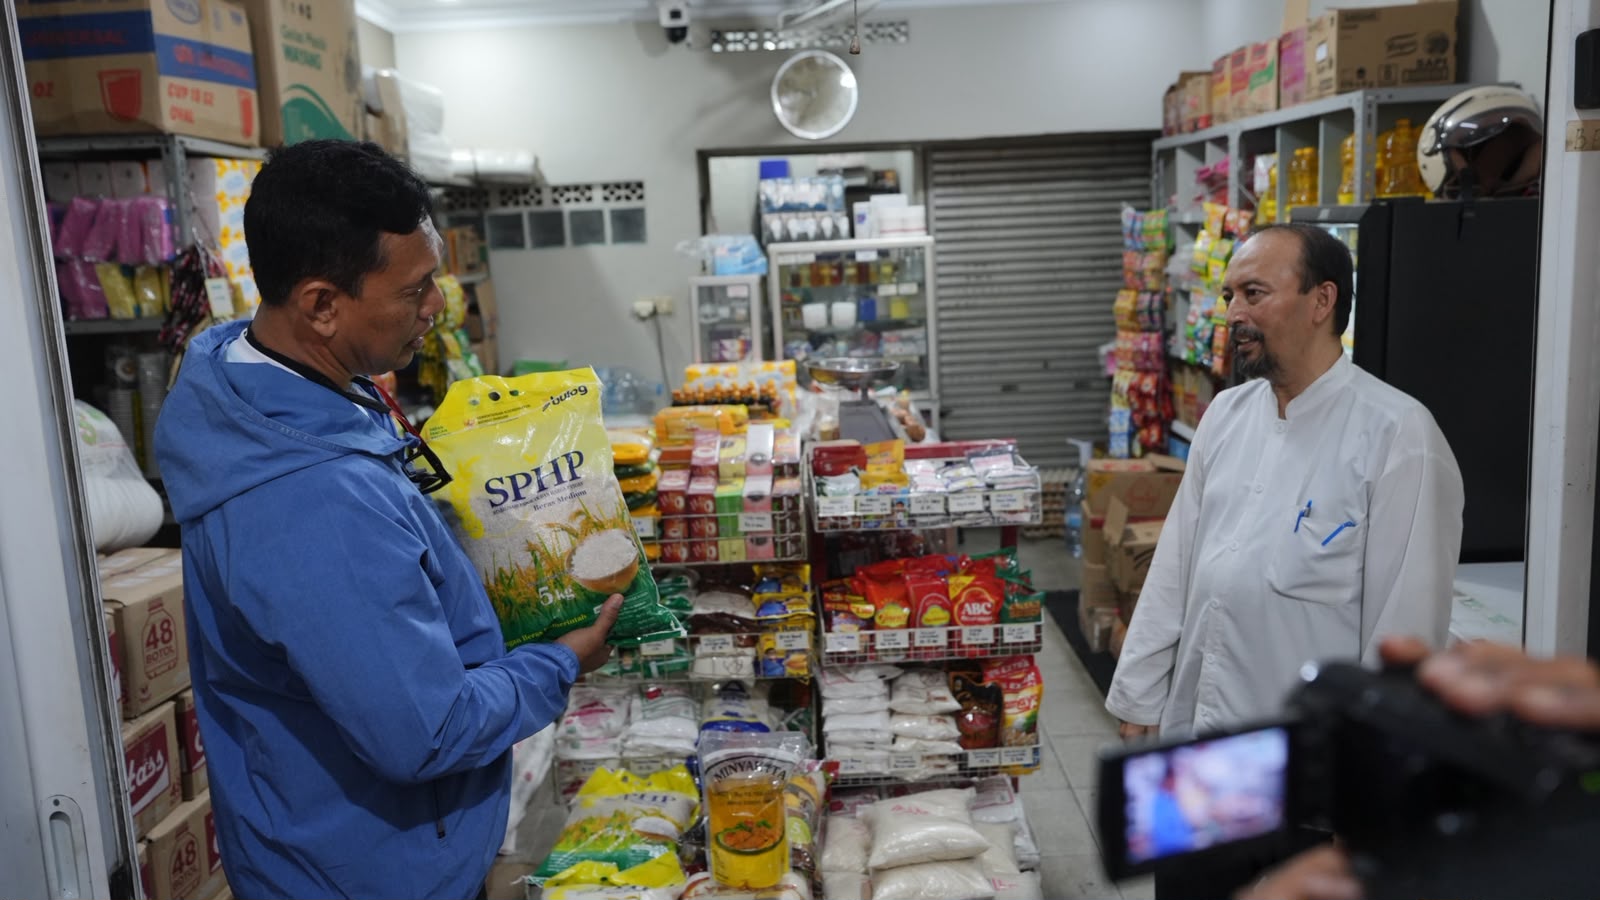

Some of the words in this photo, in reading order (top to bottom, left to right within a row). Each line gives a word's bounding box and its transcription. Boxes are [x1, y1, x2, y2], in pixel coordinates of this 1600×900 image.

[167, 83, 188, 99] CUP
[169, 105, 195, 125] OVAL
[484, 450, 585, 509] SPHP
[533, 500, 555, 512] Beras
[556, 489, 587, 504] Medium
[538, 586, 554, 606] 5
[555, 587, 576, 600] kg
[961, 602, 993, 616] ABC
[145, 618, 173, 649] 48
[146, 645, 175, 665] BOTOL
[172, 840, 196, 875] 48
[173, 864, 199, 891] BOTOL
